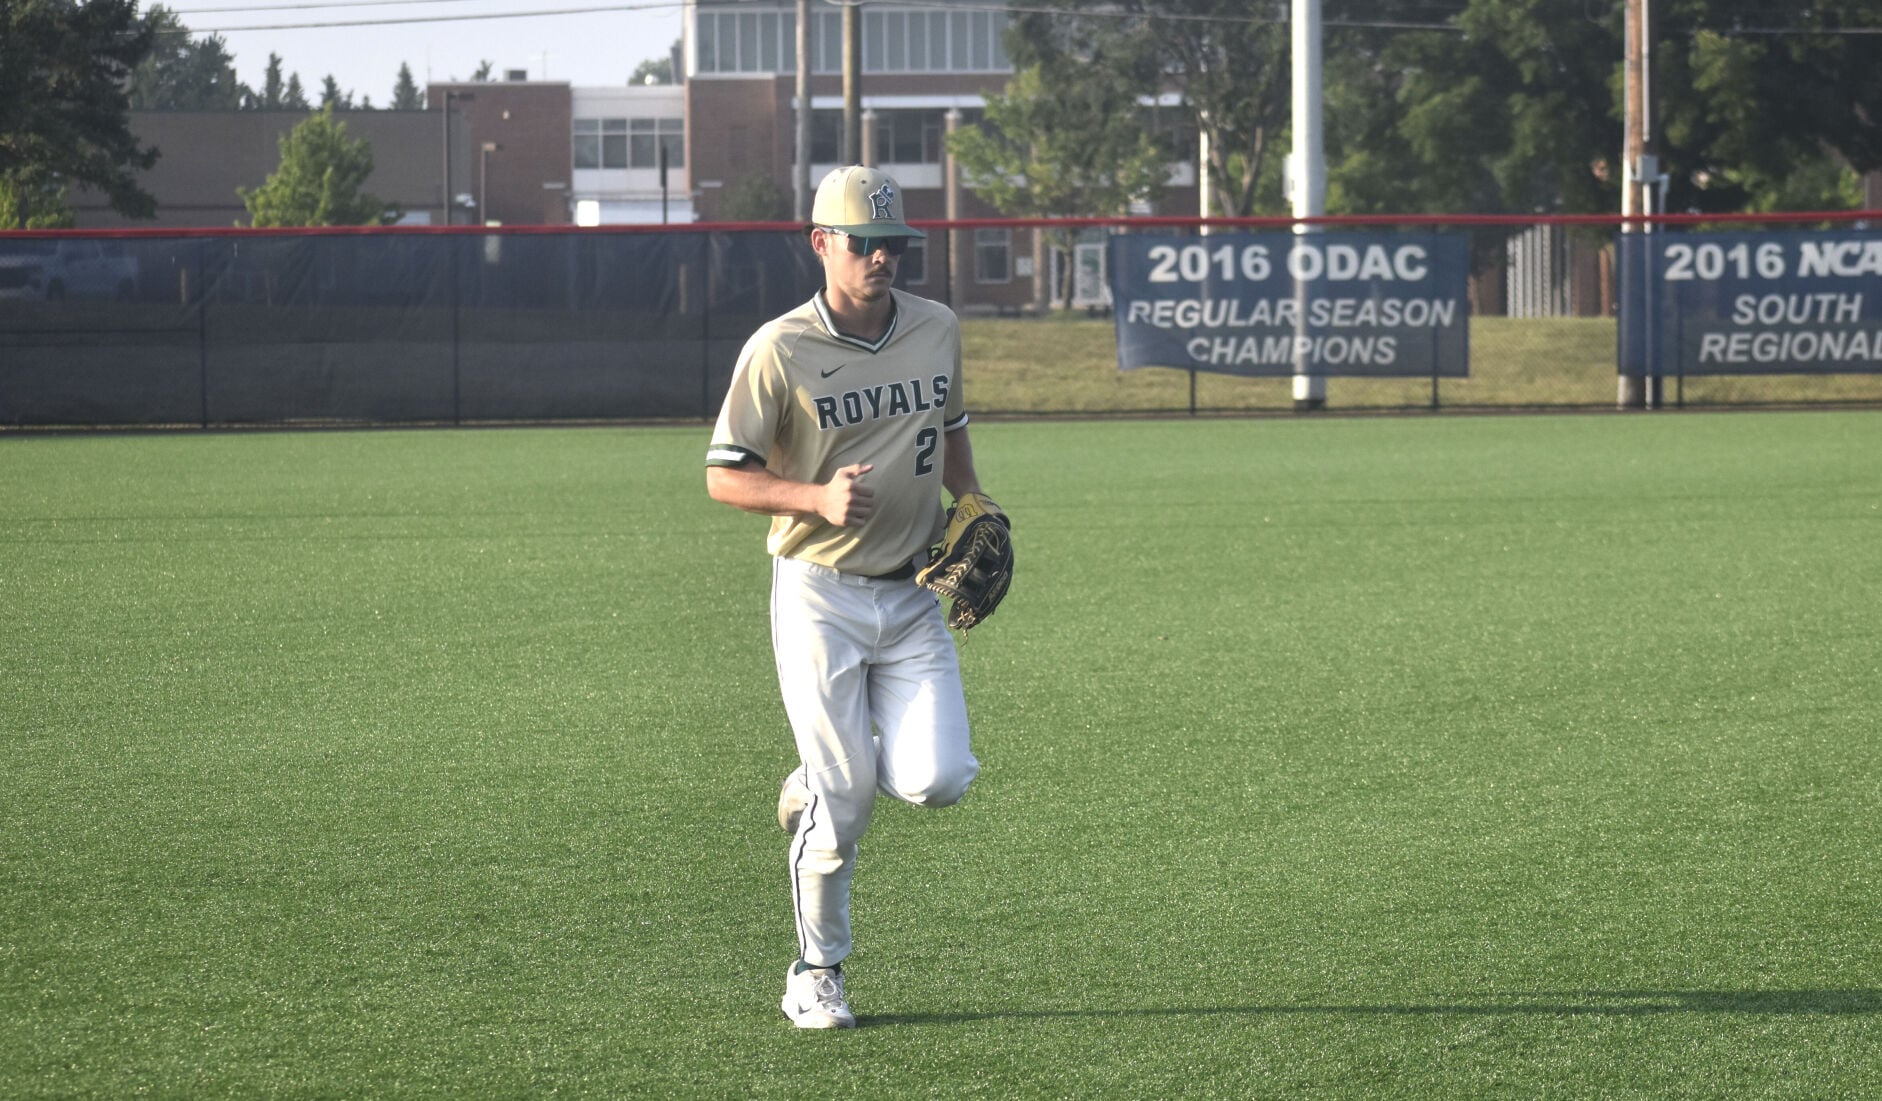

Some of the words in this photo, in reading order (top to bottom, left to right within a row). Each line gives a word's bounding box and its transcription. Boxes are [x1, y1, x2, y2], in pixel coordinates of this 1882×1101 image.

[1148, 245, 1271, 282] 2016
[1287, 244, 1428, 281] ODAC
[1664, 243, 1785, 280] 2016
[1127, 300, 1300, 328] REGULAR
[1308, 299, 1455, 327] SEASON
[1732, 293, 1863, 325] SOUTH
[1186, 336, 1397, 365] CHAMPIONS
[812, 374, 949, 431] ROYALS
[914, 426, 938, 477] 2
